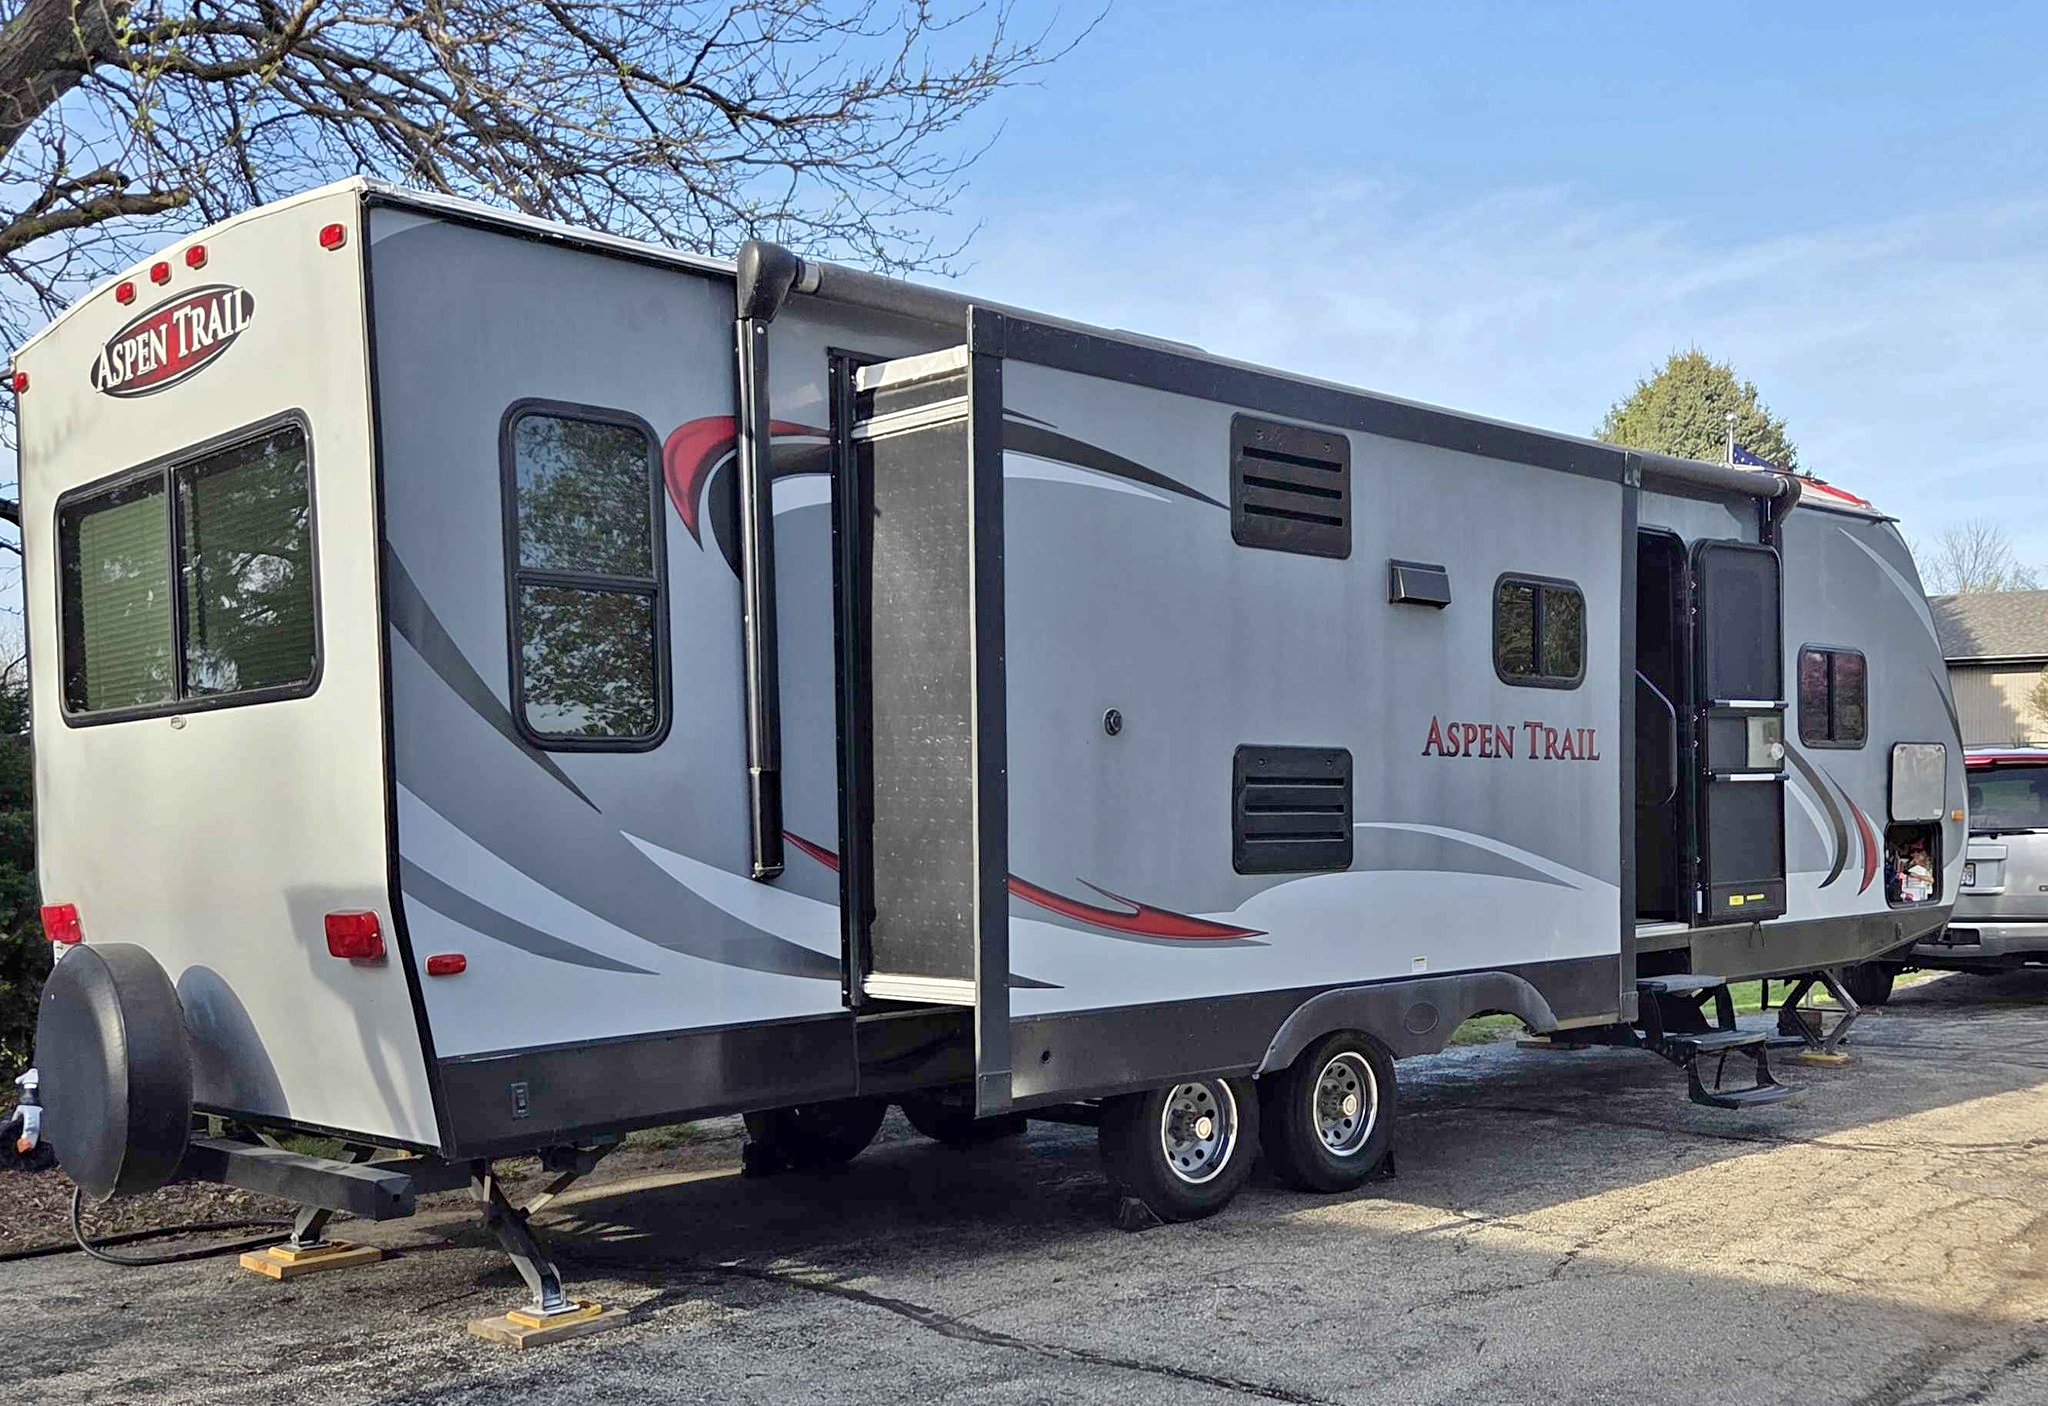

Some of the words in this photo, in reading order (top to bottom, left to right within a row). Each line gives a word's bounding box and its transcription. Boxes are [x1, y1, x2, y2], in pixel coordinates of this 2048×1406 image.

[96, 323, 168, 393] ASPEN
[172, 287, 251, 358] TRAIL
[1421, 715, 1515, 760] ASPEN
[1523, 720, 1601, 761] TRAIL
